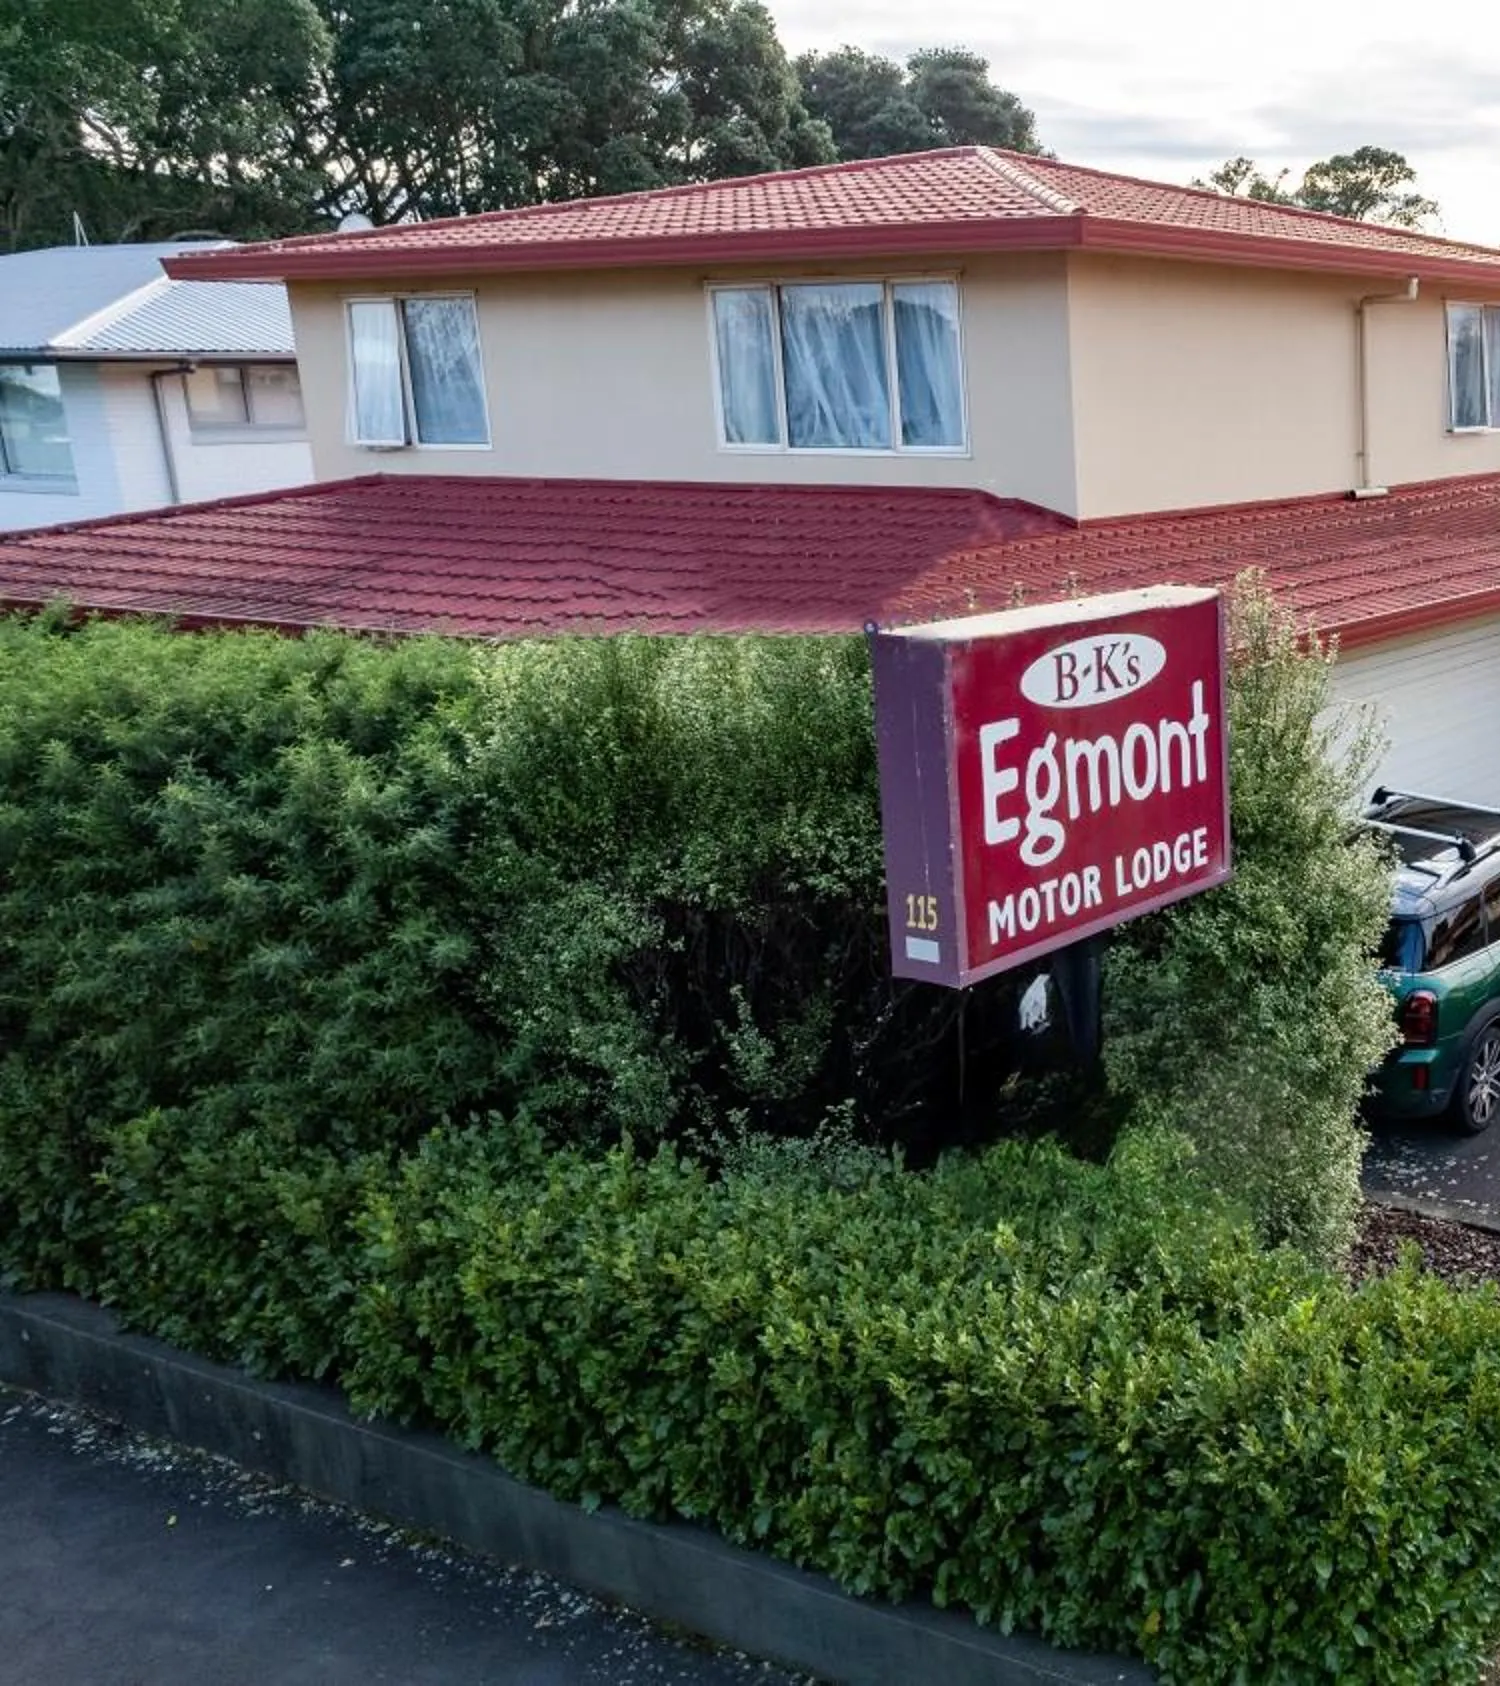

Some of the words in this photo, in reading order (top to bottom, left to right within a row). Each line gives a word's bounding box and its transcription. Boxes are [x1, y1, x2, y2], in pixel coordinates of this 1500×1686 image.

[979, 680, 1209, 867] Egmont
[906, 893, 938, 931] 115
[988, 864, 1103, 945] MOTOR
[1115, 827, 1209, 897] LODGE
